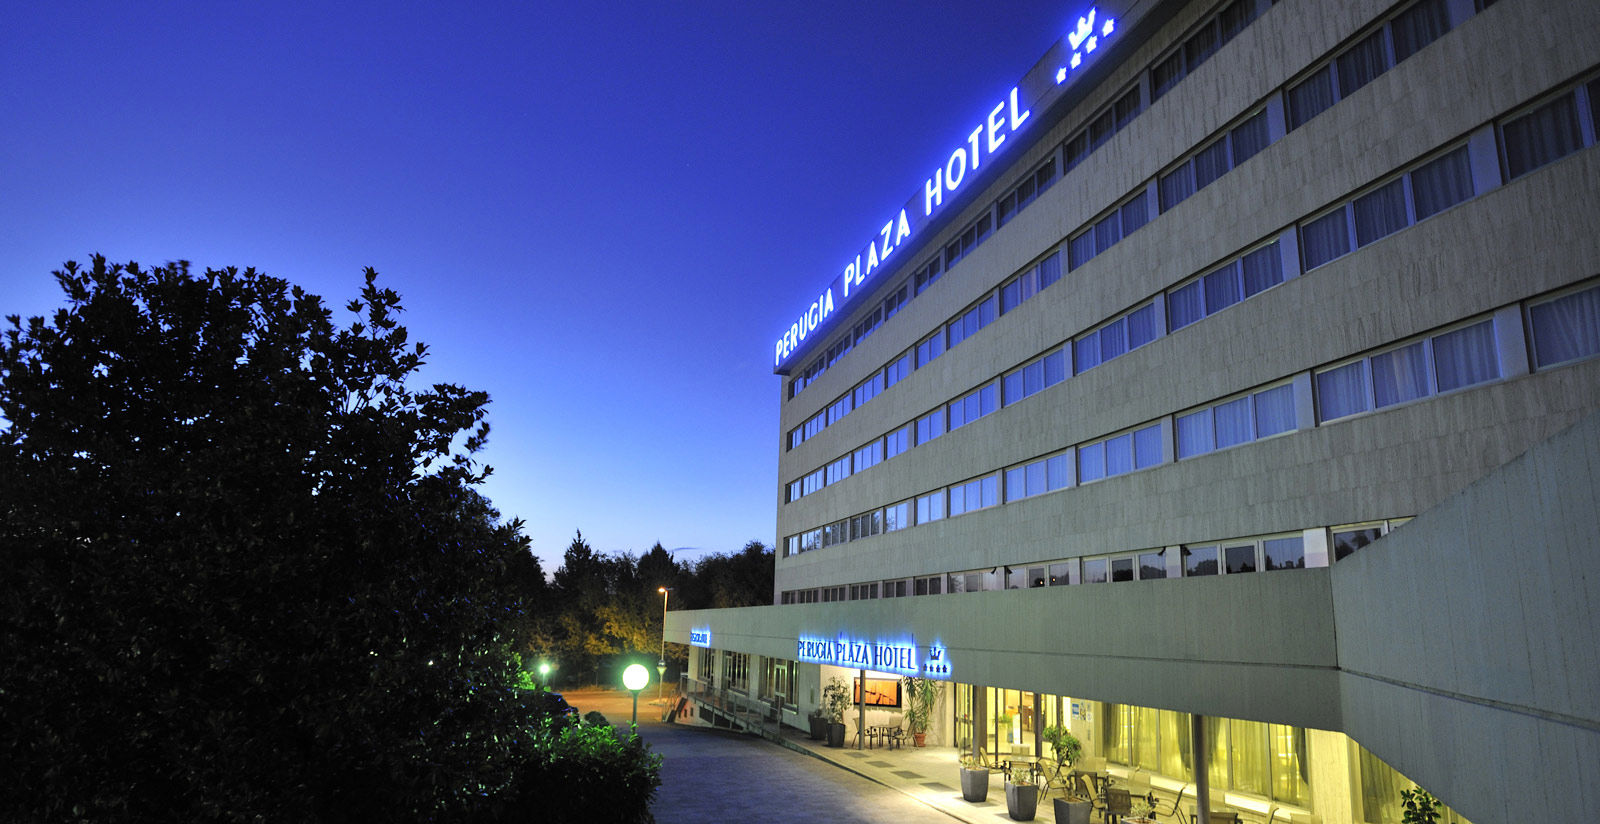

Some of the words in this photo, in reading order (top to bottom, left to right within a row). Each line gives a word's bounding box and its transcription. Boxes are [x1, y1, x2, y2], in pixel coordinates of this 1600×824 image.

[775, 287, 834, 366] PERUGIA
[844, 208, 911, 298] PLAZA
[925, 86, 1030, 217] HOTEL
[798, 640, 833, 660] PERUGIA
[837, 642, 869, 665] PLAZA
[874, 644, 916, 670] HOTEL
